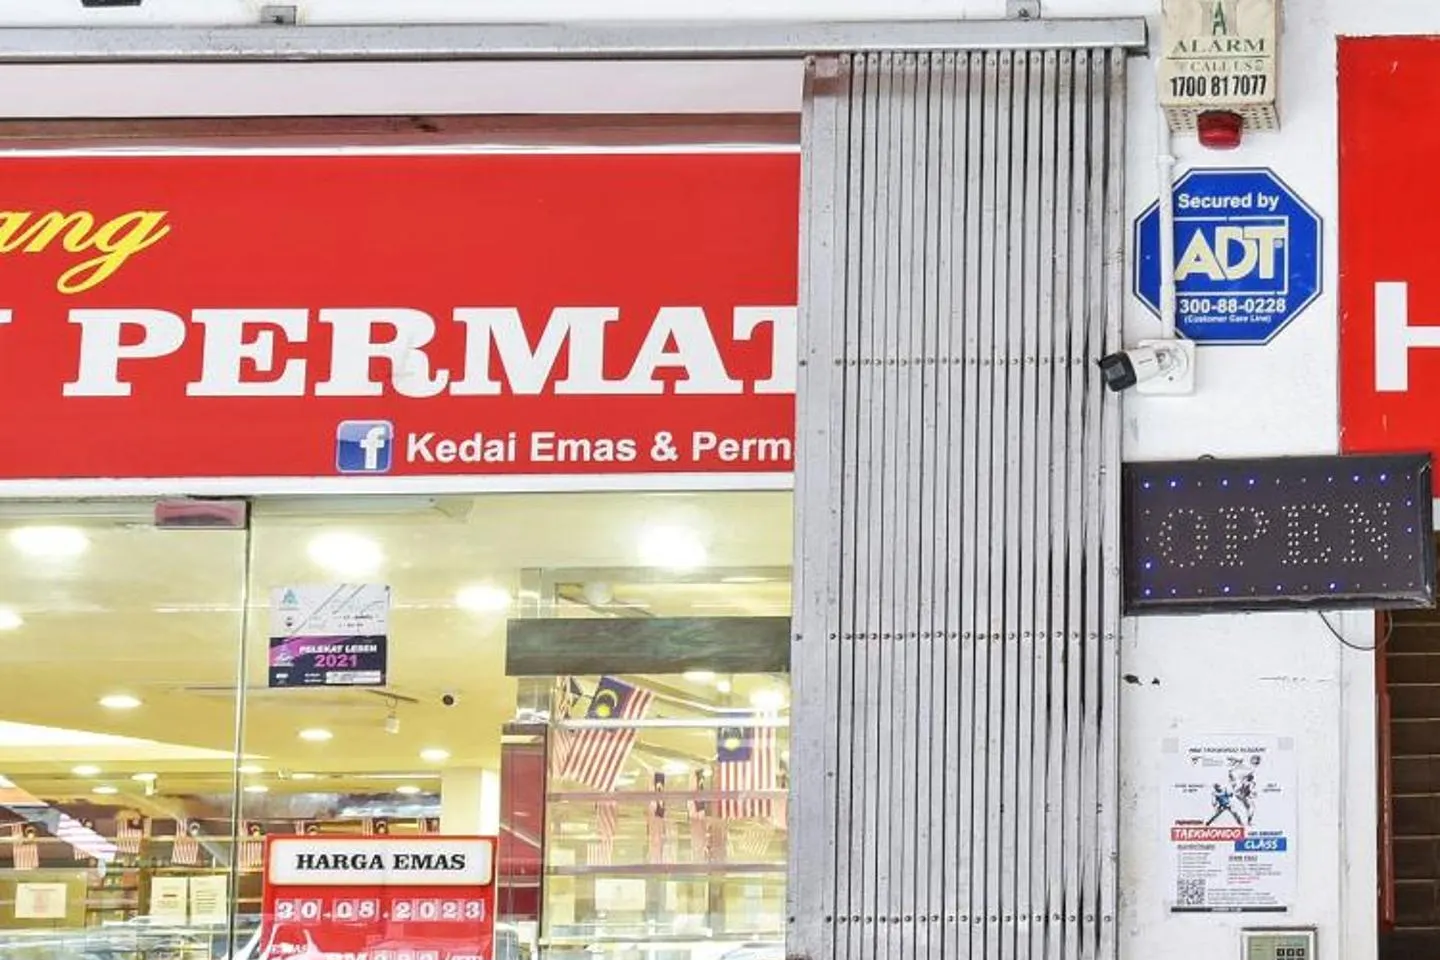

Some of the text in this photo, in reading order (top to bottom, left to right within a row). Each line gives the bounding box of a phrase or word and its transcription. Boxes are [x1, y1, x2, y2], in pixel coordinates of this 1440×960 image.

[1172, 38, 1265, 53] ALARM
[1170, 74, 1266, 97] 1700 81 7077
[1177, 193, 1280, 212] Secured by
[1175, 225, 1285, 281] ADT
[1180, 298, 1287, 314] 300-88-0228
[62, 306, 797, 398] PERMAT
[407, 431, 517, 463] Kedai
[530, 432, 637, 462] Emas
[650, 431, 679, 462] &
[692, 431, 792, 462] Perm
[1158, 502, 1391, 567] OPEN
[314, 654, 358, 667] 2021
[1174, 829, 1241, 840] TAEKWONDO
[1244, 840, 1278, 850] CLASS
[296, 854, 466, 870] HARGA EMAS
